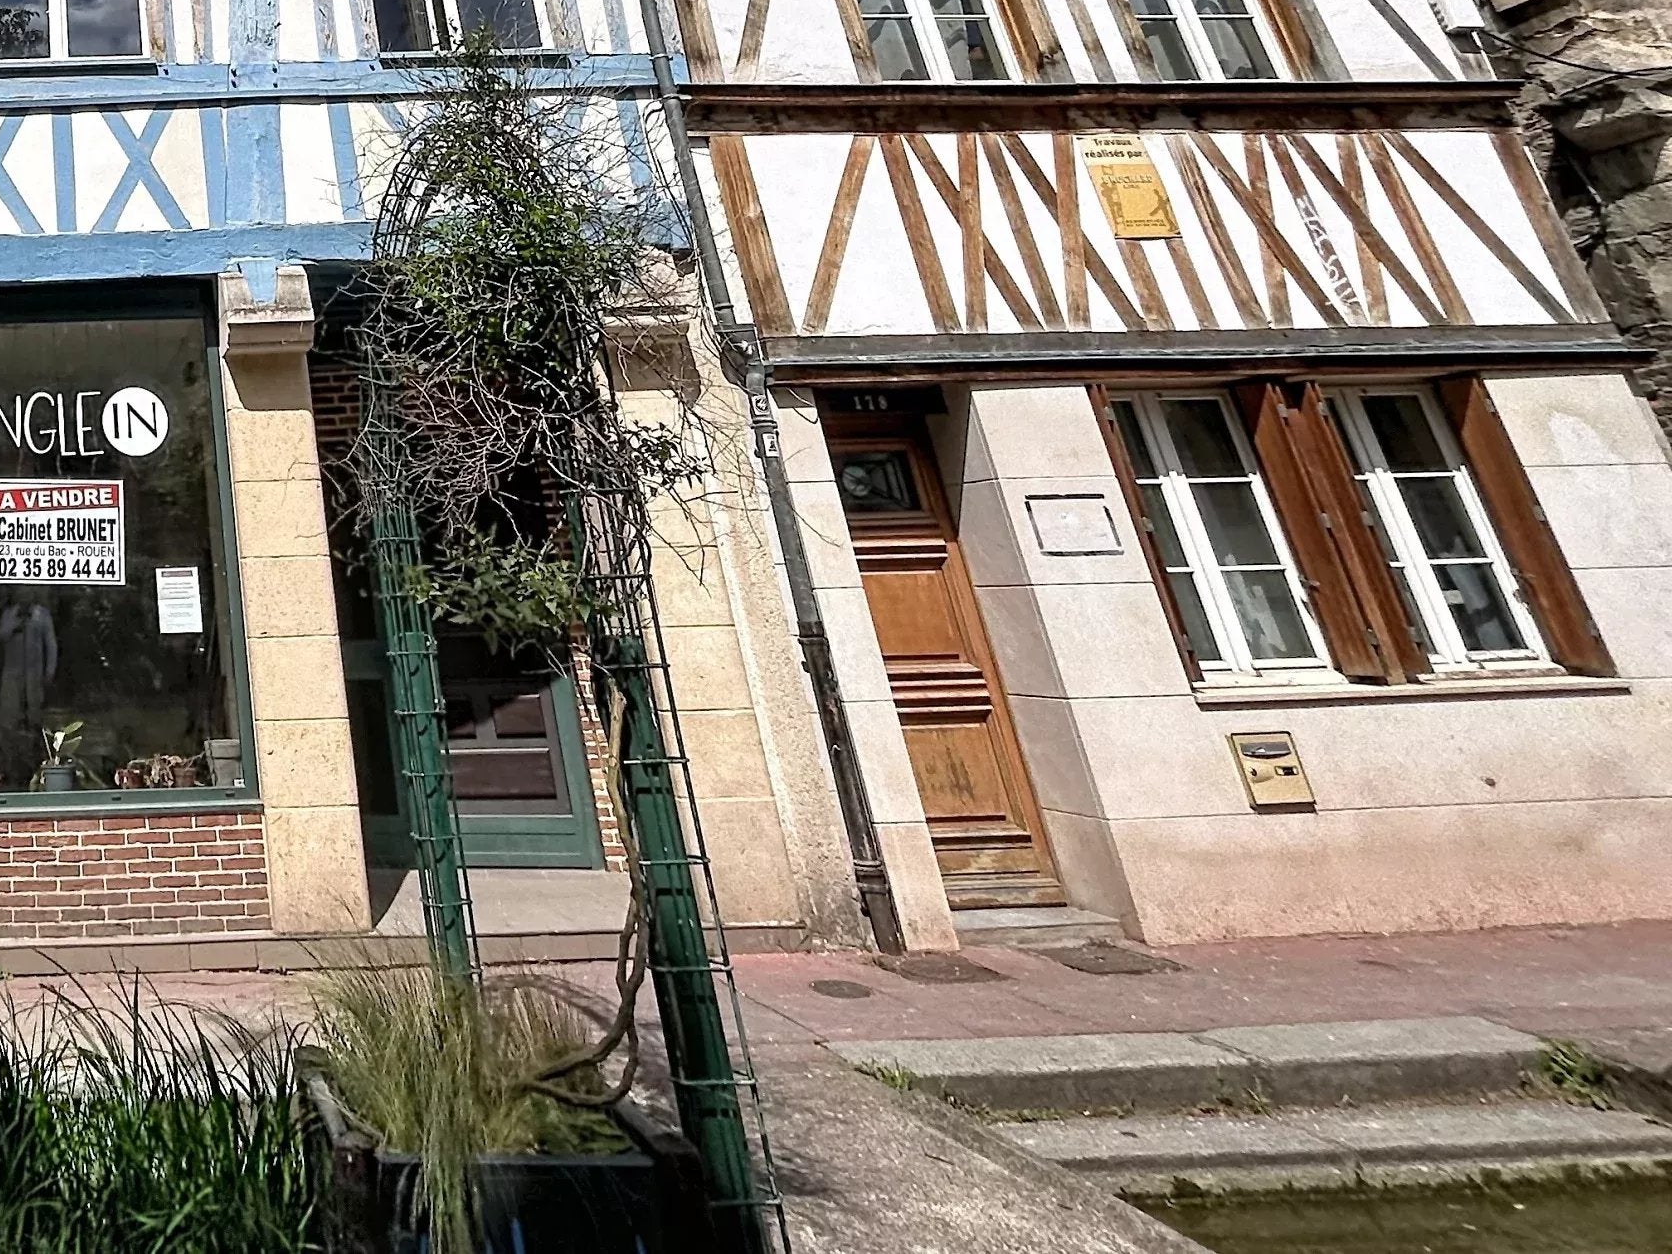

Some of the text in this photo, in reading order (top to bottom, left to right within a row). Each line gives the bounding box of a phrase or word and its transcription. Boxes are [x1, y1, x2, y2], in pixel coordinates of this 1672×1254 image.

[1093, 138, 1133, 146] Travaux
[1085, 149, 1126, 159] réalisés
[0, 487, 115, 510] A VENDRE
[56, 517, 116, 542] BRUNET
[15, 547, 32, 557] rue
[33, 545, 46, 557] du
[48, 545, 67, 557] Bac
[77, 545, 115, 557] ROUEN
[22, 558, 42, 577] 35
[47, 558, 66, 577] 89
[72, 559, 91, 578] 44
[96, 559, 116, 578] 44
